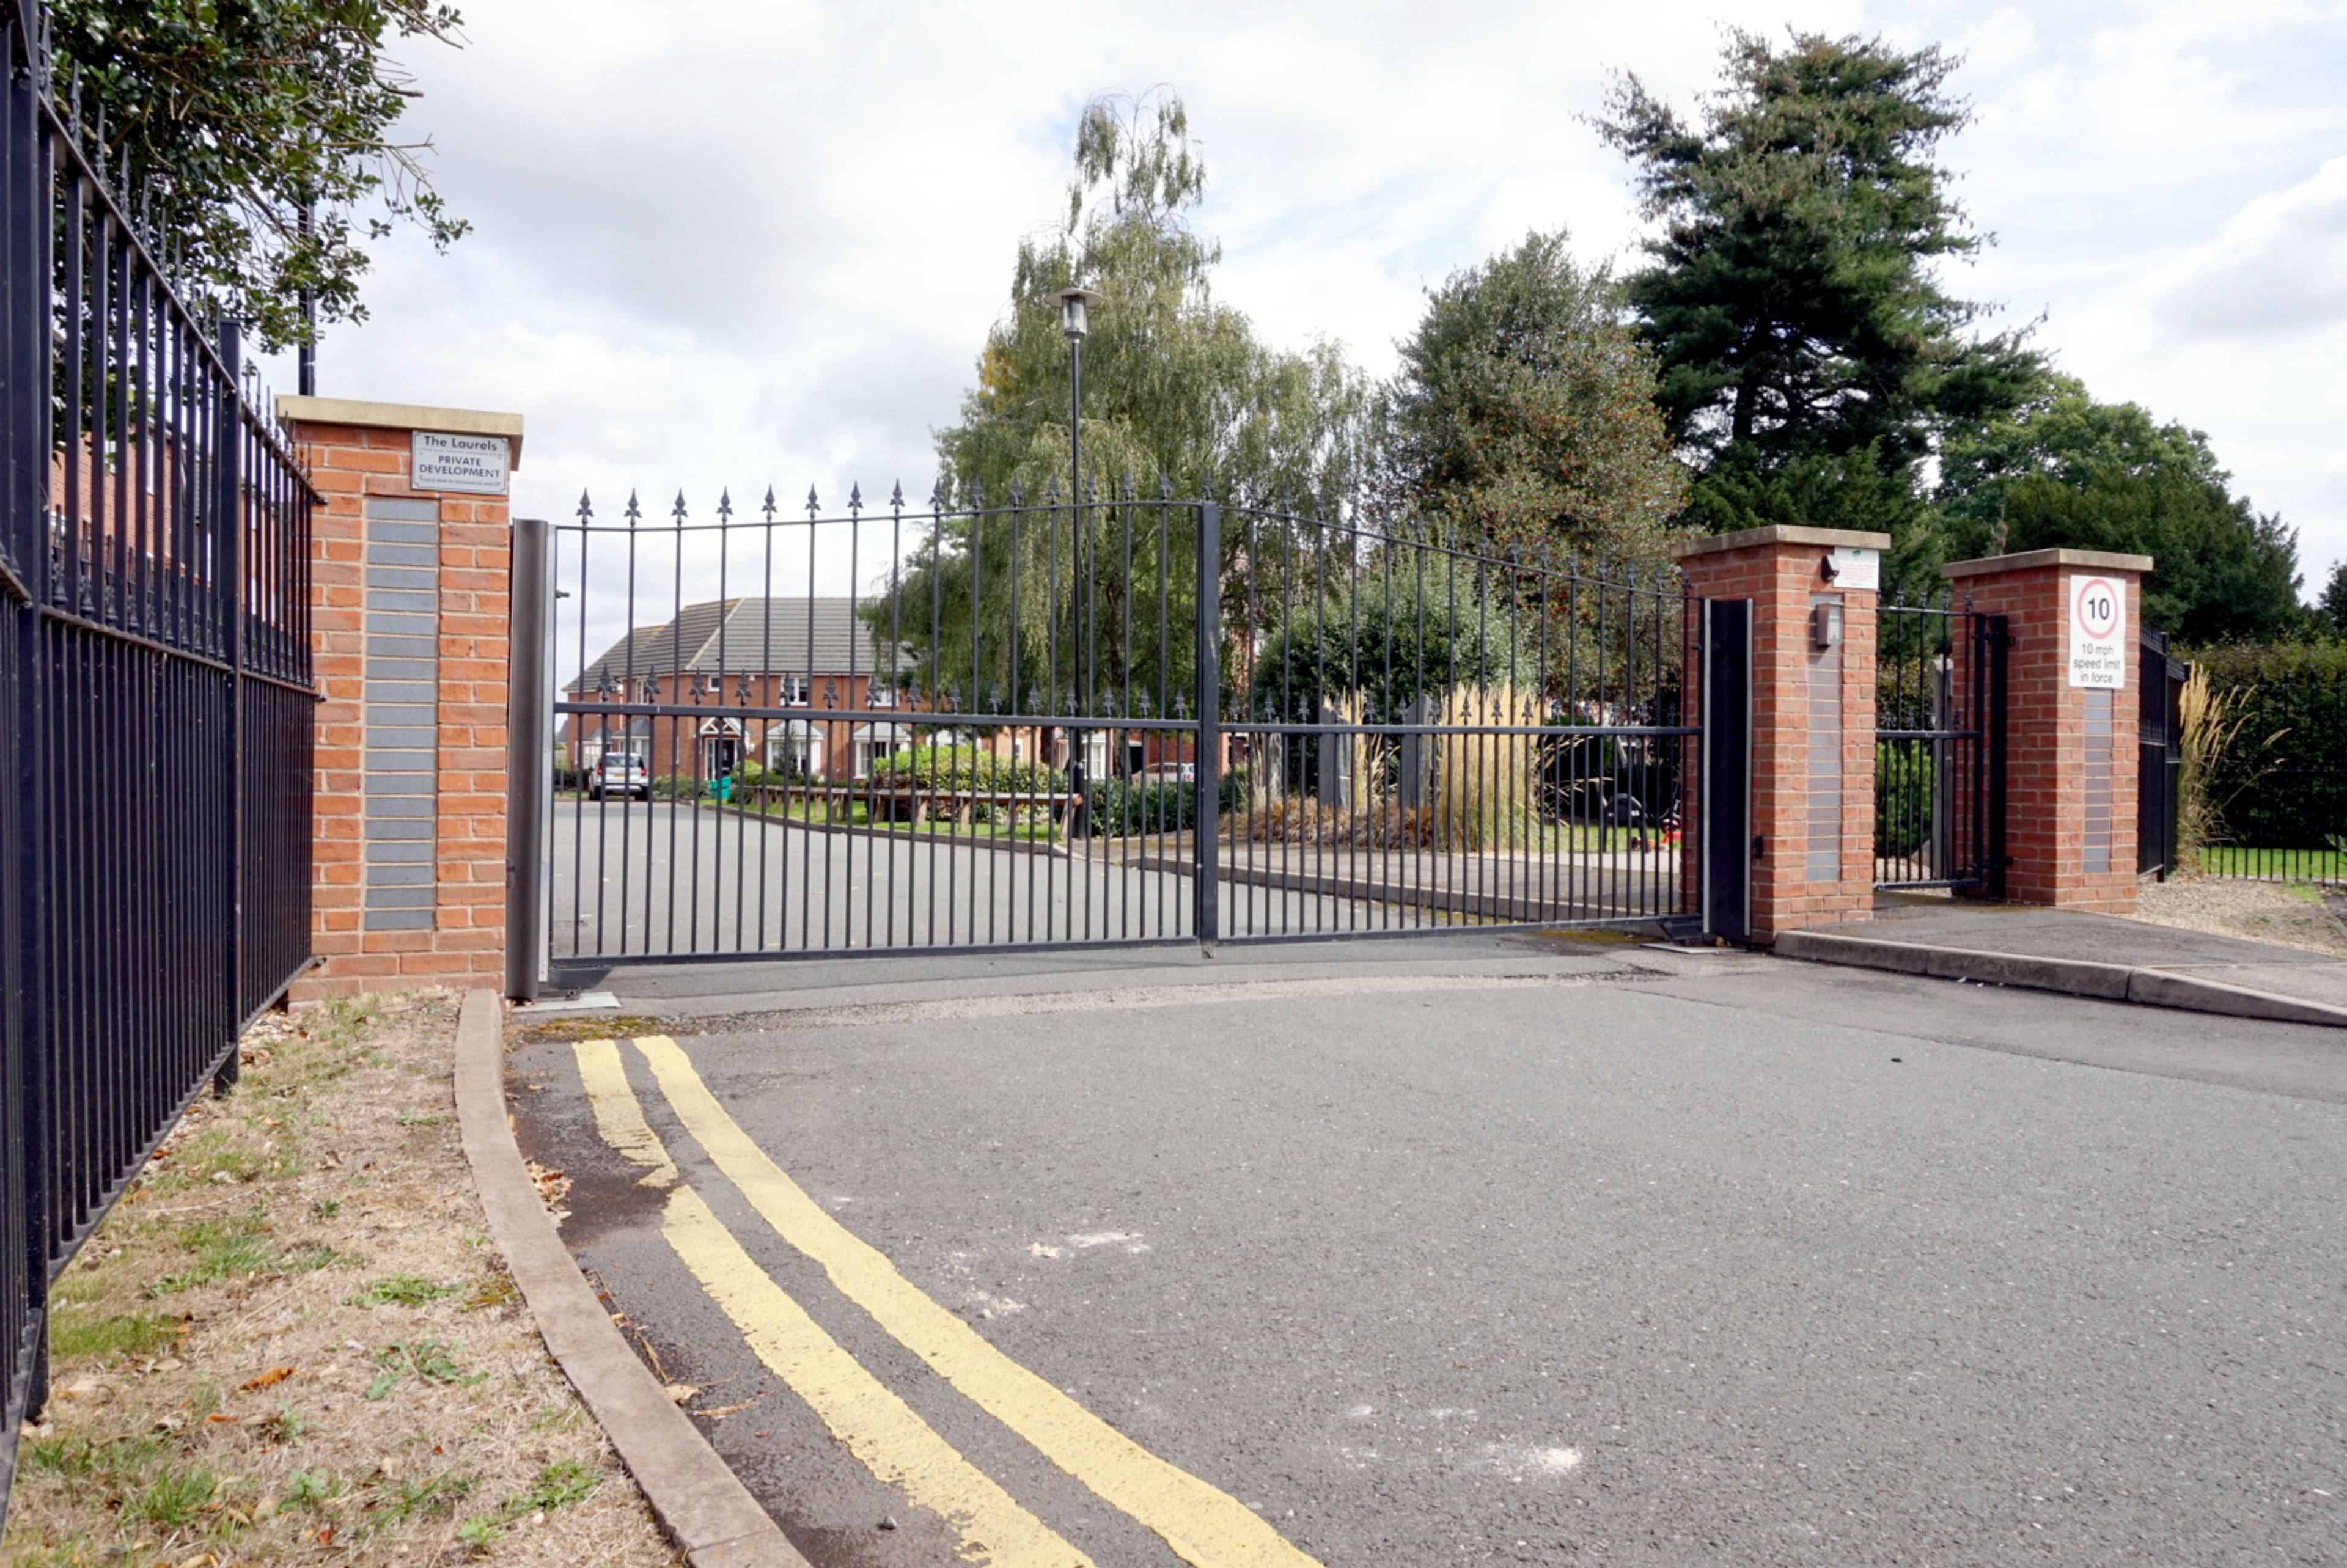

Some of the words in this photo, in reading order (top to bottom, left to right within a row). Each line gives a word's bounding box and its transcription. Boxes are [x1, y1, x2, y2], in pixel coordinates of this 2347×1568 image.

[424, 435, 447, 447] The
[452, 438, 498, 451] Laurels
[438, 455, 481, 466] PRIVATE
[419, 464, 500, 477] DEVELOPMENT
[2088, 598, 2110, 620] 10
[2082, 643, 2093, 654] 10
[2096, 645, 2114, 656] mph
[2074, 658, 2101, 670] speed
[2104, 659, 2120, 670] limit
[2080, 673, 2088, 682] in
[2091, 672, 2113, 683] force
